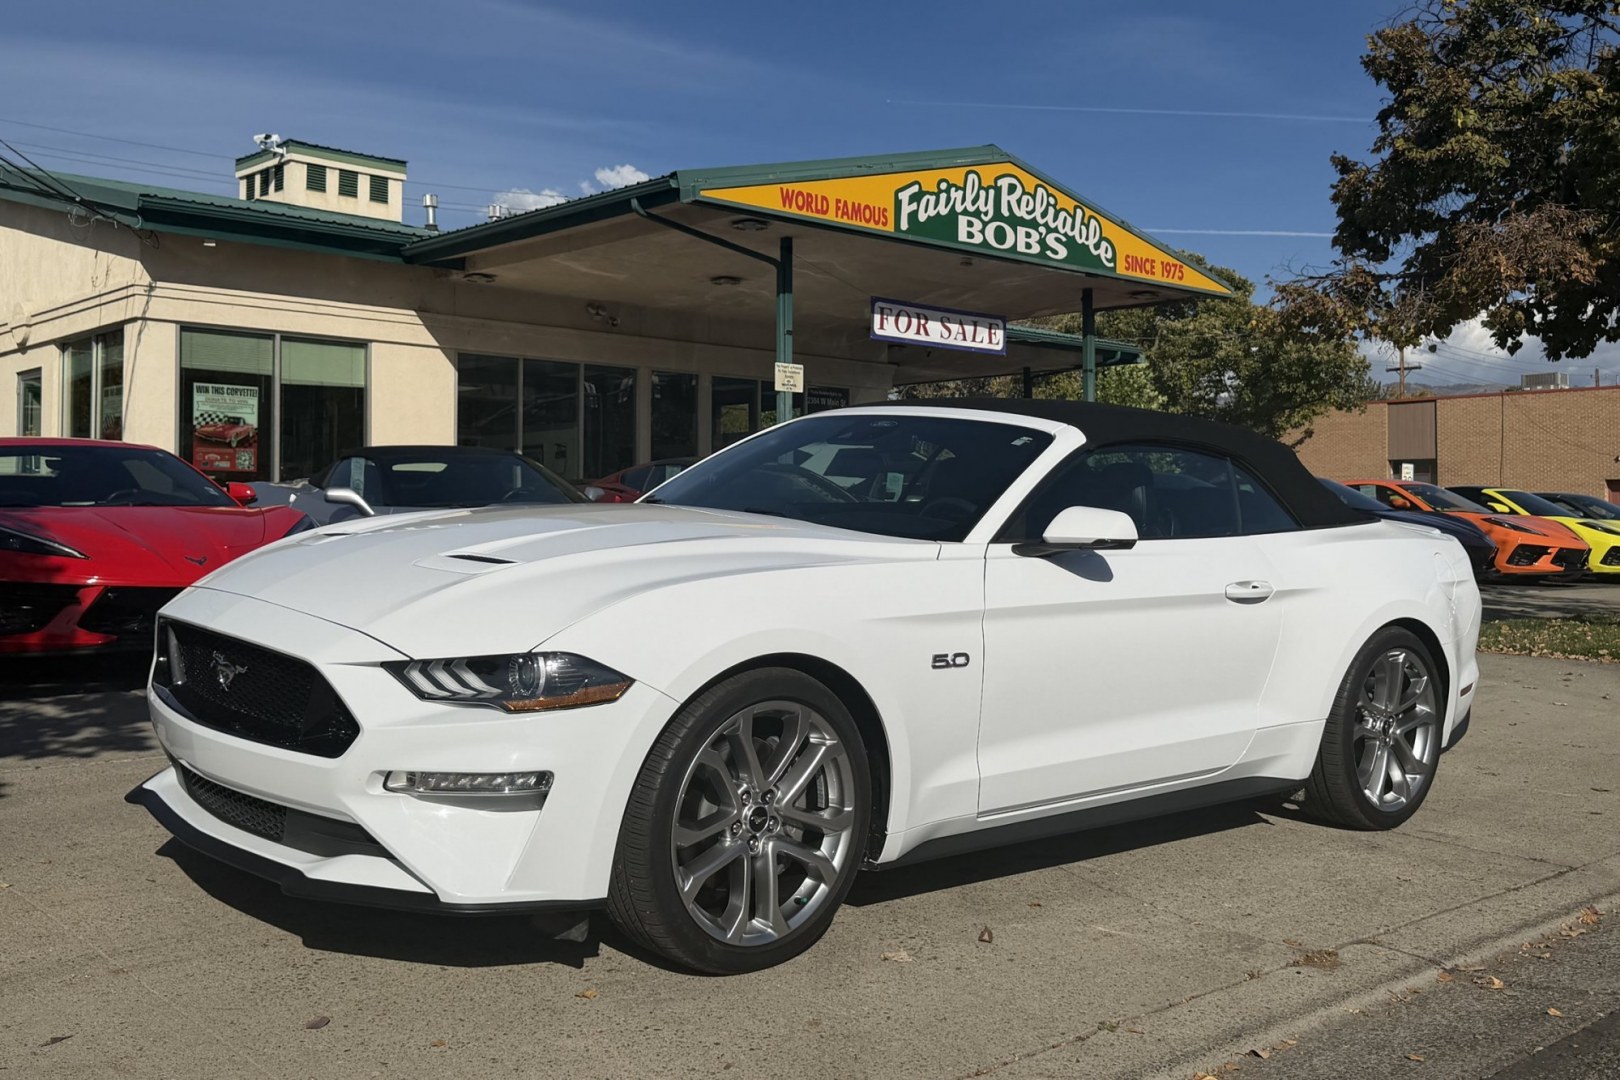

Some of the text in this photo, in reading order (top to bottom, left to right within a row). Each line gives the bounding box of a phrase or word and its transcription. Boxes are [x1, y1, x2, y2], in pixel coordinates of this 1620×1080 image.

[780, 186, 889, 227] WORLD FAMOUS
[898, 173, 1115, 267] Fairly Reliable
[957, 214, 1068, 260] BOB'S
[1124, 254, 1184, 281] SINCE 1975
[878, 305, 1000, 346] FOR SALE
[195, 384, 210, 394] WIN
[210, 385, 225, 396] THIS
